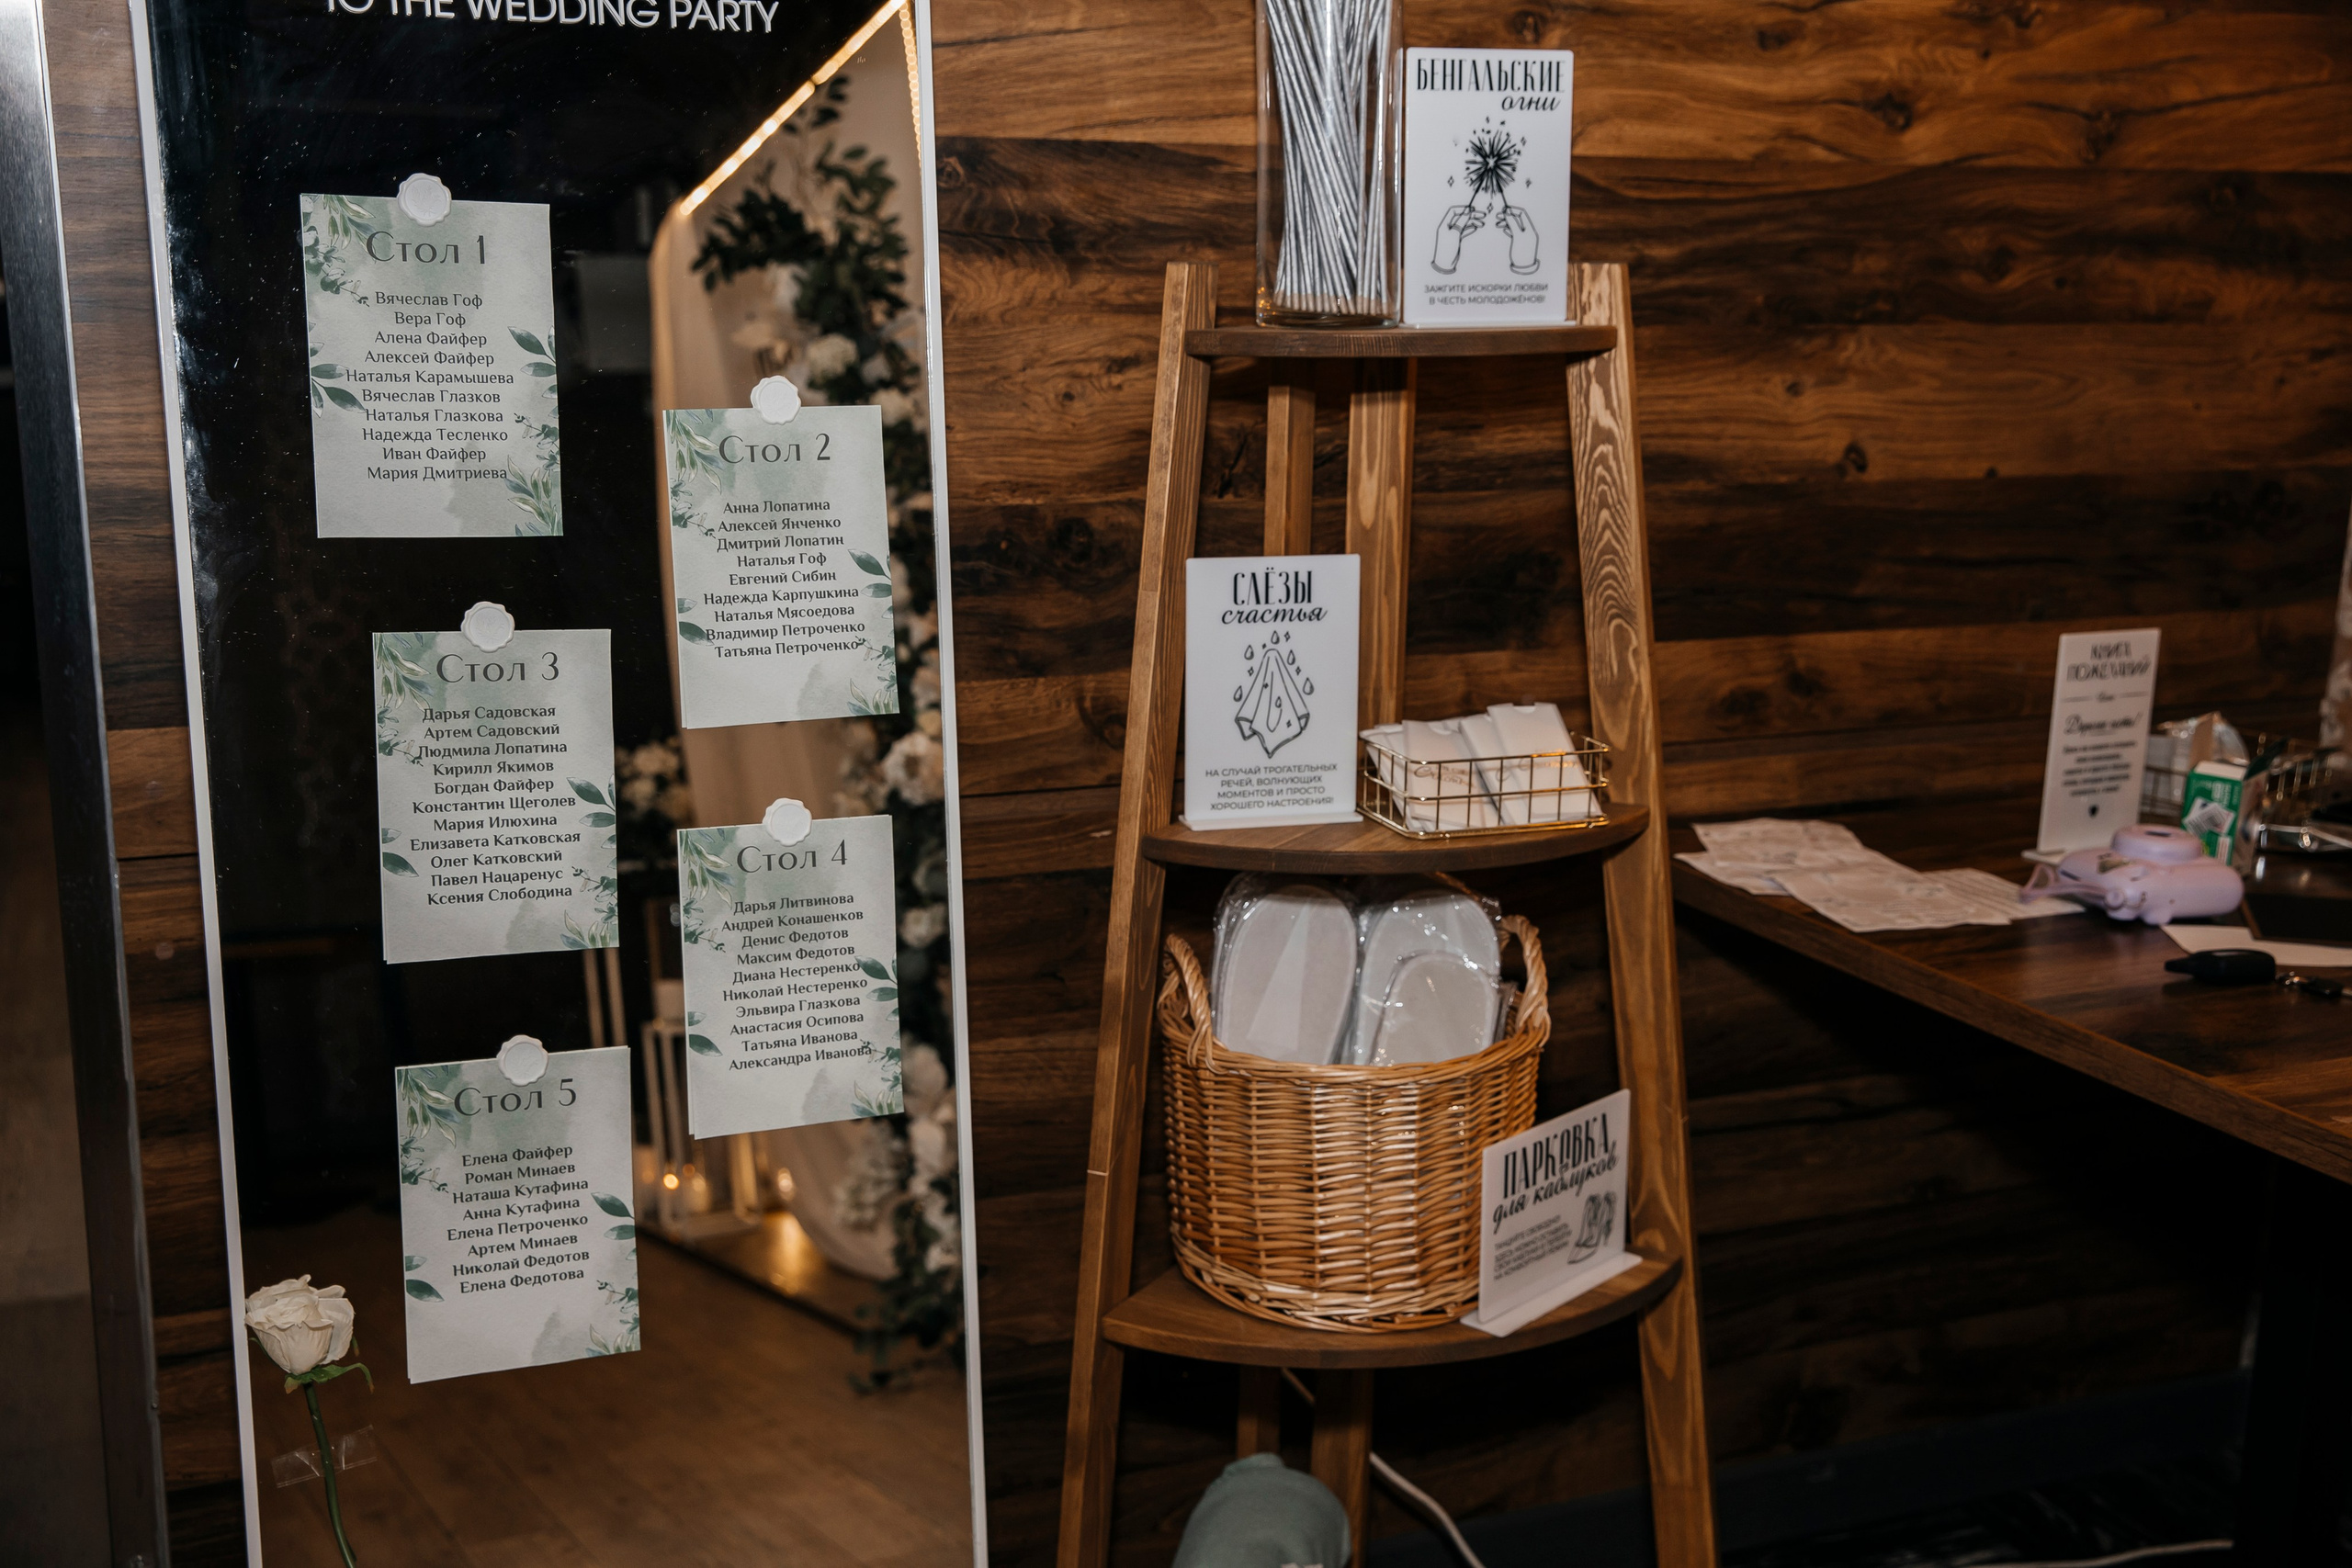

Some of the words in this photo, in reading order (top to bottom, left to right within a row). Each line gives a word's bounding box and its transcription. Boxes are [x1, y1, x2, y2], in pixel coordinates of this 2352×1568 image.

[467, 0, 660, 28] WEDDING
[670, 0, 779, 33] PARTY
[1417, 59, 1566, 93] БЕНГАЛЬСКИЕ
[1501, 96, 1560, 112] огни
[366, 231, 458, 264] Стол
[477, 235, 484, 264] 1
[1424, 284, 1466, 293] ЗАЖГИТЕ
[1468, 284, 1511, 292] ИСКОРКИ
[1513, 283, 1549, 292] ЛЮБВИ
[376, 292, 448, 305] Вячеслав
[453, 294, 482, 310] Гоф
[1429, 297, 1435, 305] В
[1437, 297, 1466, 305] ЧЕСТЬ
[394, 311, 431, 327] Вера
[436, 313, 466, 328] Гоф
[375, 332, 422, 344] Алена
[427, 332, 486, 348] Файфер
[365, 351, 429, 363] Алексей
[435, 351, 493, 367] Файфер
[345, 369, 410, 382] Наталья
[415, 370, 514, 386] Карамышева
[362, 389, 435, 401] Вячеслав
[440, 390, 500, 402] Глазков
[366, 409, 429, 421] Наталья
[435, 410, 503, 422] Глазкова
[362, 428, 431, 443] Надежда
[436, 429, 507, 441] Тесленко
[383, 447, 422, 459] Иван
[426, 447, 486, 462] Файфер
[719, 435, 800, 463] Стол
[816, 434, 830, 460] 2
[368, 467, 418, 481] Мария
[423, 467, 507, 482] Дмитриева
[724, 502, 759, 513] Анна
[763, 501, 830, 513] Лопатина
[718, 520, 776, 532] Алексей
[782, 518, 841, 529] Янченко
[718, 537, 780, 552] Дмитрий
[785, 536, 843, 547] Лопатин
[737, 556, 795, 567] Наталья
[799, 552, 826, 566] Гоф
[729, 573, 787, 585] Евгений
[792, 570, 836, 582] Сибин
[1232, 567, 1313, 606] СЛЁЗЫ
[704, 593, 767, 606] Надежда
[772, 589, 858, 603] Карпушкина
[715, 611, 773, 622] Наталья
[777, 606, 854, 618] Мясоедова
[1221, 607, 1328, 625] счастья
[706, 628, 778, 640] Владимир
[782, 624, 865, 638] Петроченко
[715, 647, 771, 658] Татьяна
[775, 641, 858, 655] Петроченко
[436, 654, 525, 682] Стол
[542, 652, 559, 681] 3
[423, 708, 469, 723] Дарья
[475, 706, 555, 720] Садовская
[424, 728, 472, 741] Артем
[477, 724, 560, 739] Садовский
[417, 746, 490, 759] Людмила
[495, 743, 567, 755] Лопатина
[433, 764, 492, 778] Кирилл
[497, 761, 554, 773] Якимов
[1205, 768, 1219, 777] НА
[1222, 764, 1261, 776] СЛУЧАЙ
[1264, 762, 1338, 774] ТРОГАТЕЛЬНЫХ
[435, 783, 489, 795] Богдан
[493, 779, 554, 793] Файфер
[1220, 776, 1254, 787] РЕЧЕЙ,
[1256, 775, 1322, 787] ВОЛНУЮЩИХ
[1217, 788, 1274, 799] МОМЕНТОВ
[1277, 788, 1283, 796] И
[1286, 786, 1326, 796] ПРОСТО
[413, 801, 504, 813] Константин
[510, 797, 575, 810] Щеголев
[1210, 800, 1264, 810] ХОРОШЕГО
[1267, 797, 1334, 808] НАСТРОЕНИЯ!
[435, 819, 484, 832] Мария
[489, 817, 557, 828] Илюхина
[411, 839, 489, 851] Елизавета
[493, 833, 580, 846] Катковская
[431, 856, 469, 868] Олег
[473, 851, 561, 865] Катковский
[737, 846, 816, 873] Стол
[831, 840, 847, 864] 4
[431, 874, 477, 886] Павел
[482, 871, 562, 884] Нацаренус
[427, 893, 483, 905] Ксения
[489, 887, 571, 901] Слободина
[734, 901, 775, 916] Дарья
[780, 896, 854, 909] Литвинова
[722, 918, 774, 932] Андрей
[778, 912, 863, 926] Конашенков
[742, 936, 785, 950] Денис
[789, 930, 848, 943] Федотов
[738, 953, 791, 964] Максим
[796, 947, 854, 960] Федотов
[733, 971, 775, 986] Диана
[780, 963, 860, 978] Нестеренко
[723, 987, 783, 1001] Николай
[787, 979, 867, 995] Нестеренко
[736, 1004, 795, 1017] Эльвира
[799, 998, 860, 1010] Глазкова
[730, 1021, 802, 1035] Анастасия
[807, 1014, 864, 1027] Осипова
[741, 1039, 797, 1051] Татьяна
[801, 1032, 857, 1045] Иванова
[729, 1054, 810, 1070] Александра
[815, 1046, 872, 1060] Иванова
[454, 1088, 542, 1116] Стол
[559, 1078, 576, 1106] 5
[462, 1154, 507, 1167] Елена
[513, 1146, 572, 1161] Файфер
[1504, 1112, 1609, 1199] ПАРКОВКА
[465, 1171, 513, 1184] Роман
[518, 1165, 575, 1179] Минаев
[453, 1190, 510, 1203] Наташа
[514, 1180, 588, 1198] Кутафина
[1493, 1194, 1529, 1235] для
[1532, 1140, 1617, 1204] каблуков
[463, 1209, 501, 1220] Анна
[506, 1200, 580, 1217] Кутафина
[447, 1227, 493, 1241] Елена
[498, 1216, 588, 1235] Петроченко
[468, 1243, 515, 1258] Артем
[520, 1235, 577, 1249] Минаев
[453, 1258, 519, 1276] Николай
[524, 1252, 589, 1267] Федотов
[460, 1280, 505, 1293] Елена
[510, 1270, 583, 1287] Федотова
